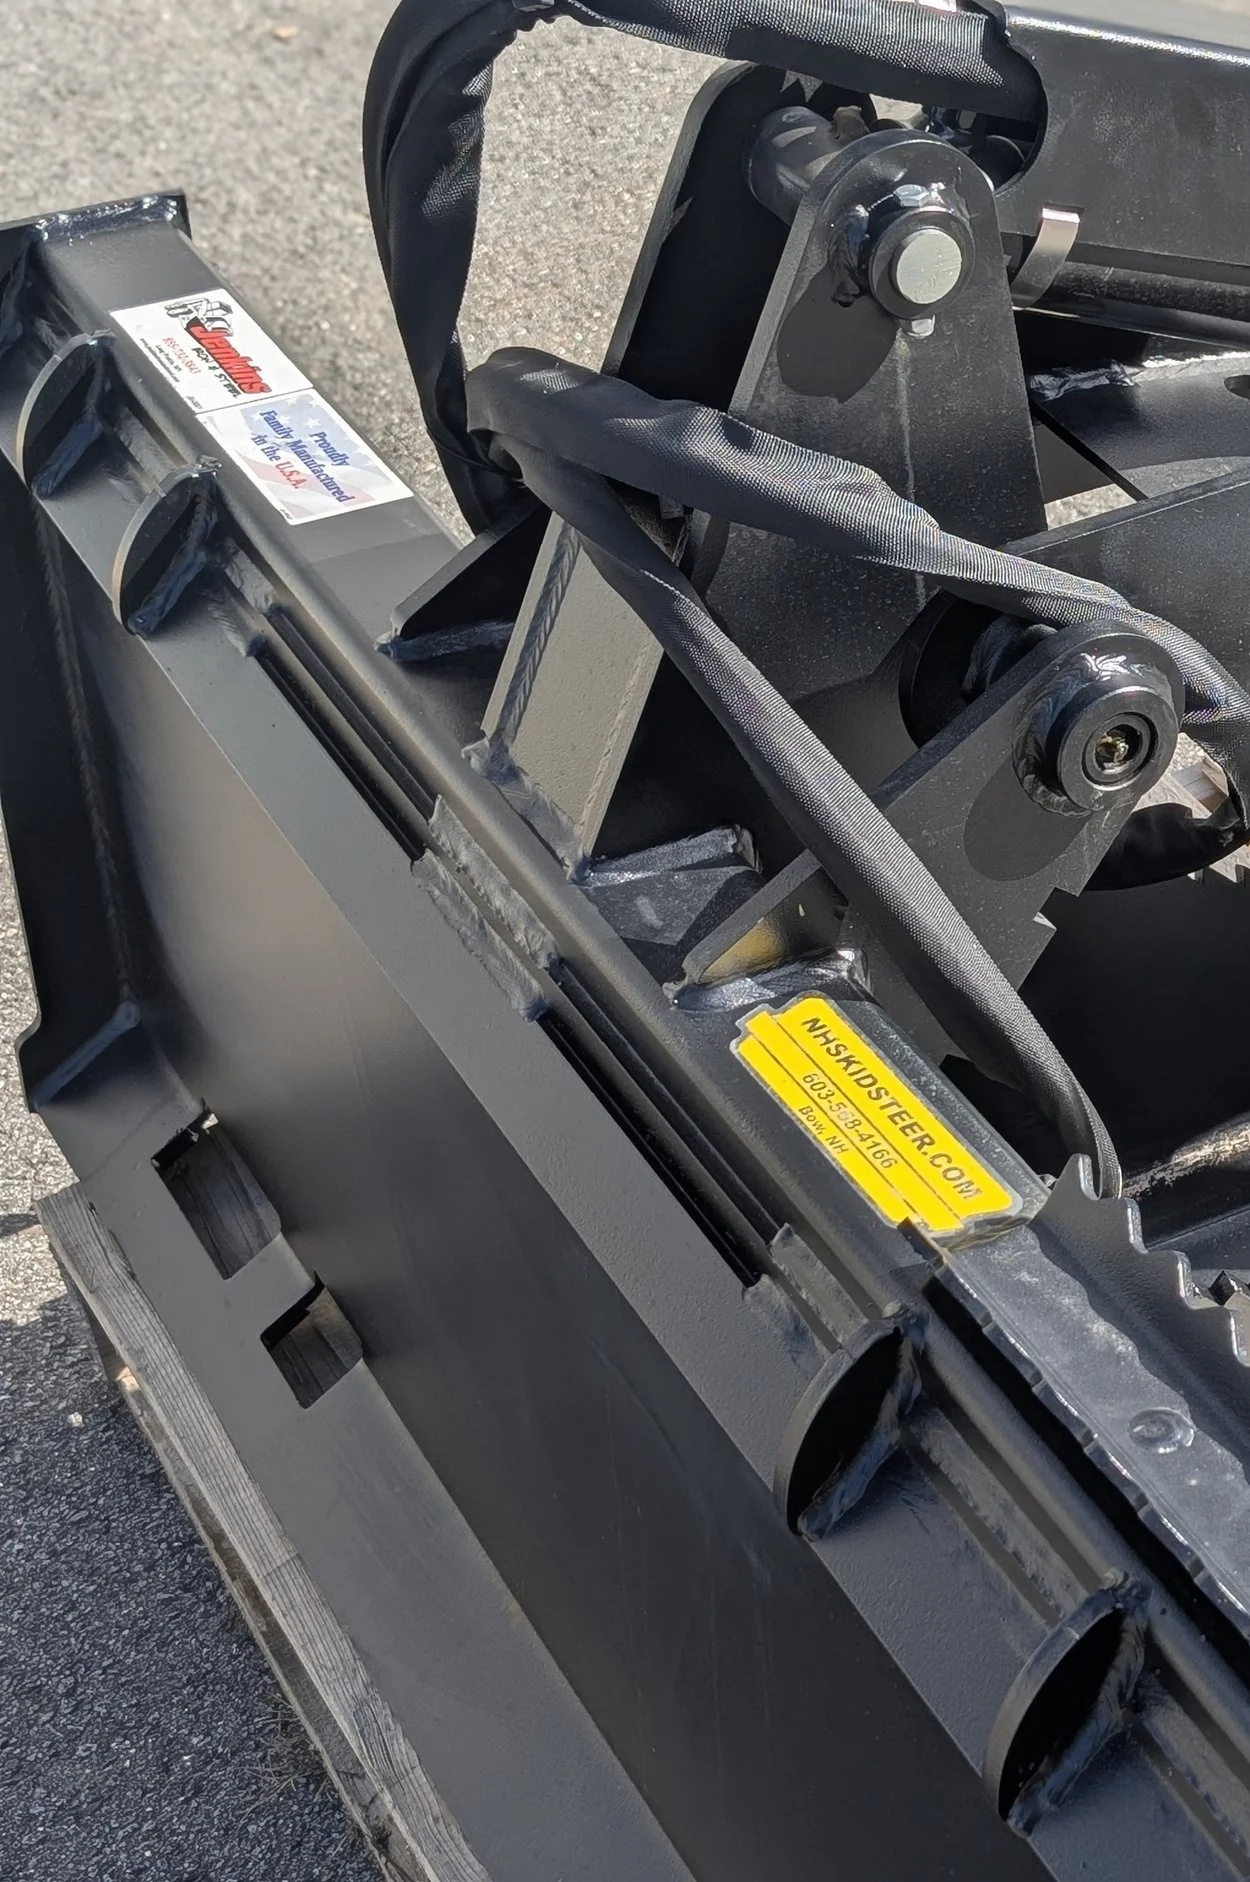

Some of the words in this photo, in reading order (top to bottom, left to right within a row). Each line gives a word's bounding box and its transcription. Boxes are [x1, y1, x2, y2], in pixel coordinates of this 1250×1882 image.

[186, 326, 272, 393] Jenkins
[250, 434, 268, 446] in
[260, 445, 281, 462] the
[275, 461, 307, 489] U.S.A.
[260, 410, 294, 439] Family
[286, 439, 356, 502] Manufactured
[309, 431, 350, 466] Proudly
[798, 1105, 827, 1135] Bow,
[825, 1135, 850, 1154] NH
[801, 1016, 983, 1200] NHSKIDSTEER.COM
